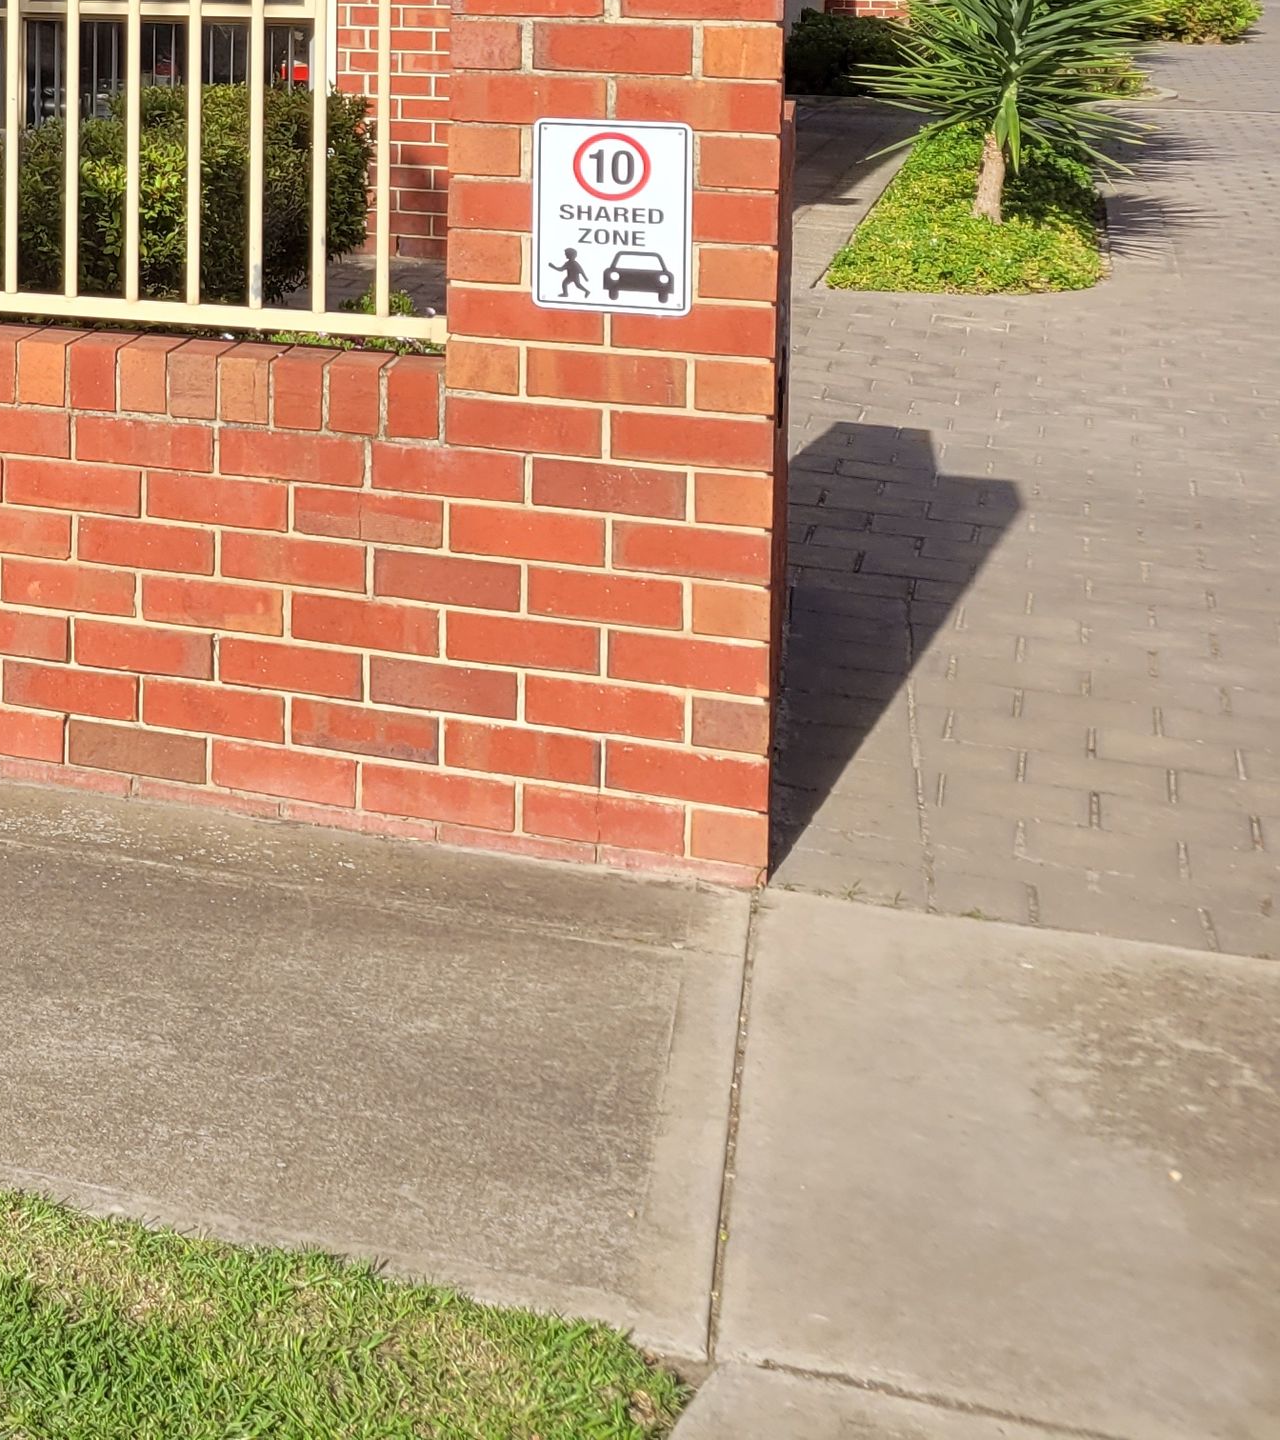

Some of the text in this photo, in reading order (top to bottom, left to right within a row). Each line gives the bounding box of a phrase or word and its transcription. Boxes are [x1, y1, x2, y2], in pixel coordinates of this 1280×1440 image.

[589, 149, 635, 185] 10
[559, 204, 664, 224] SHARED
[578, 228, 645, 246] ZONE
